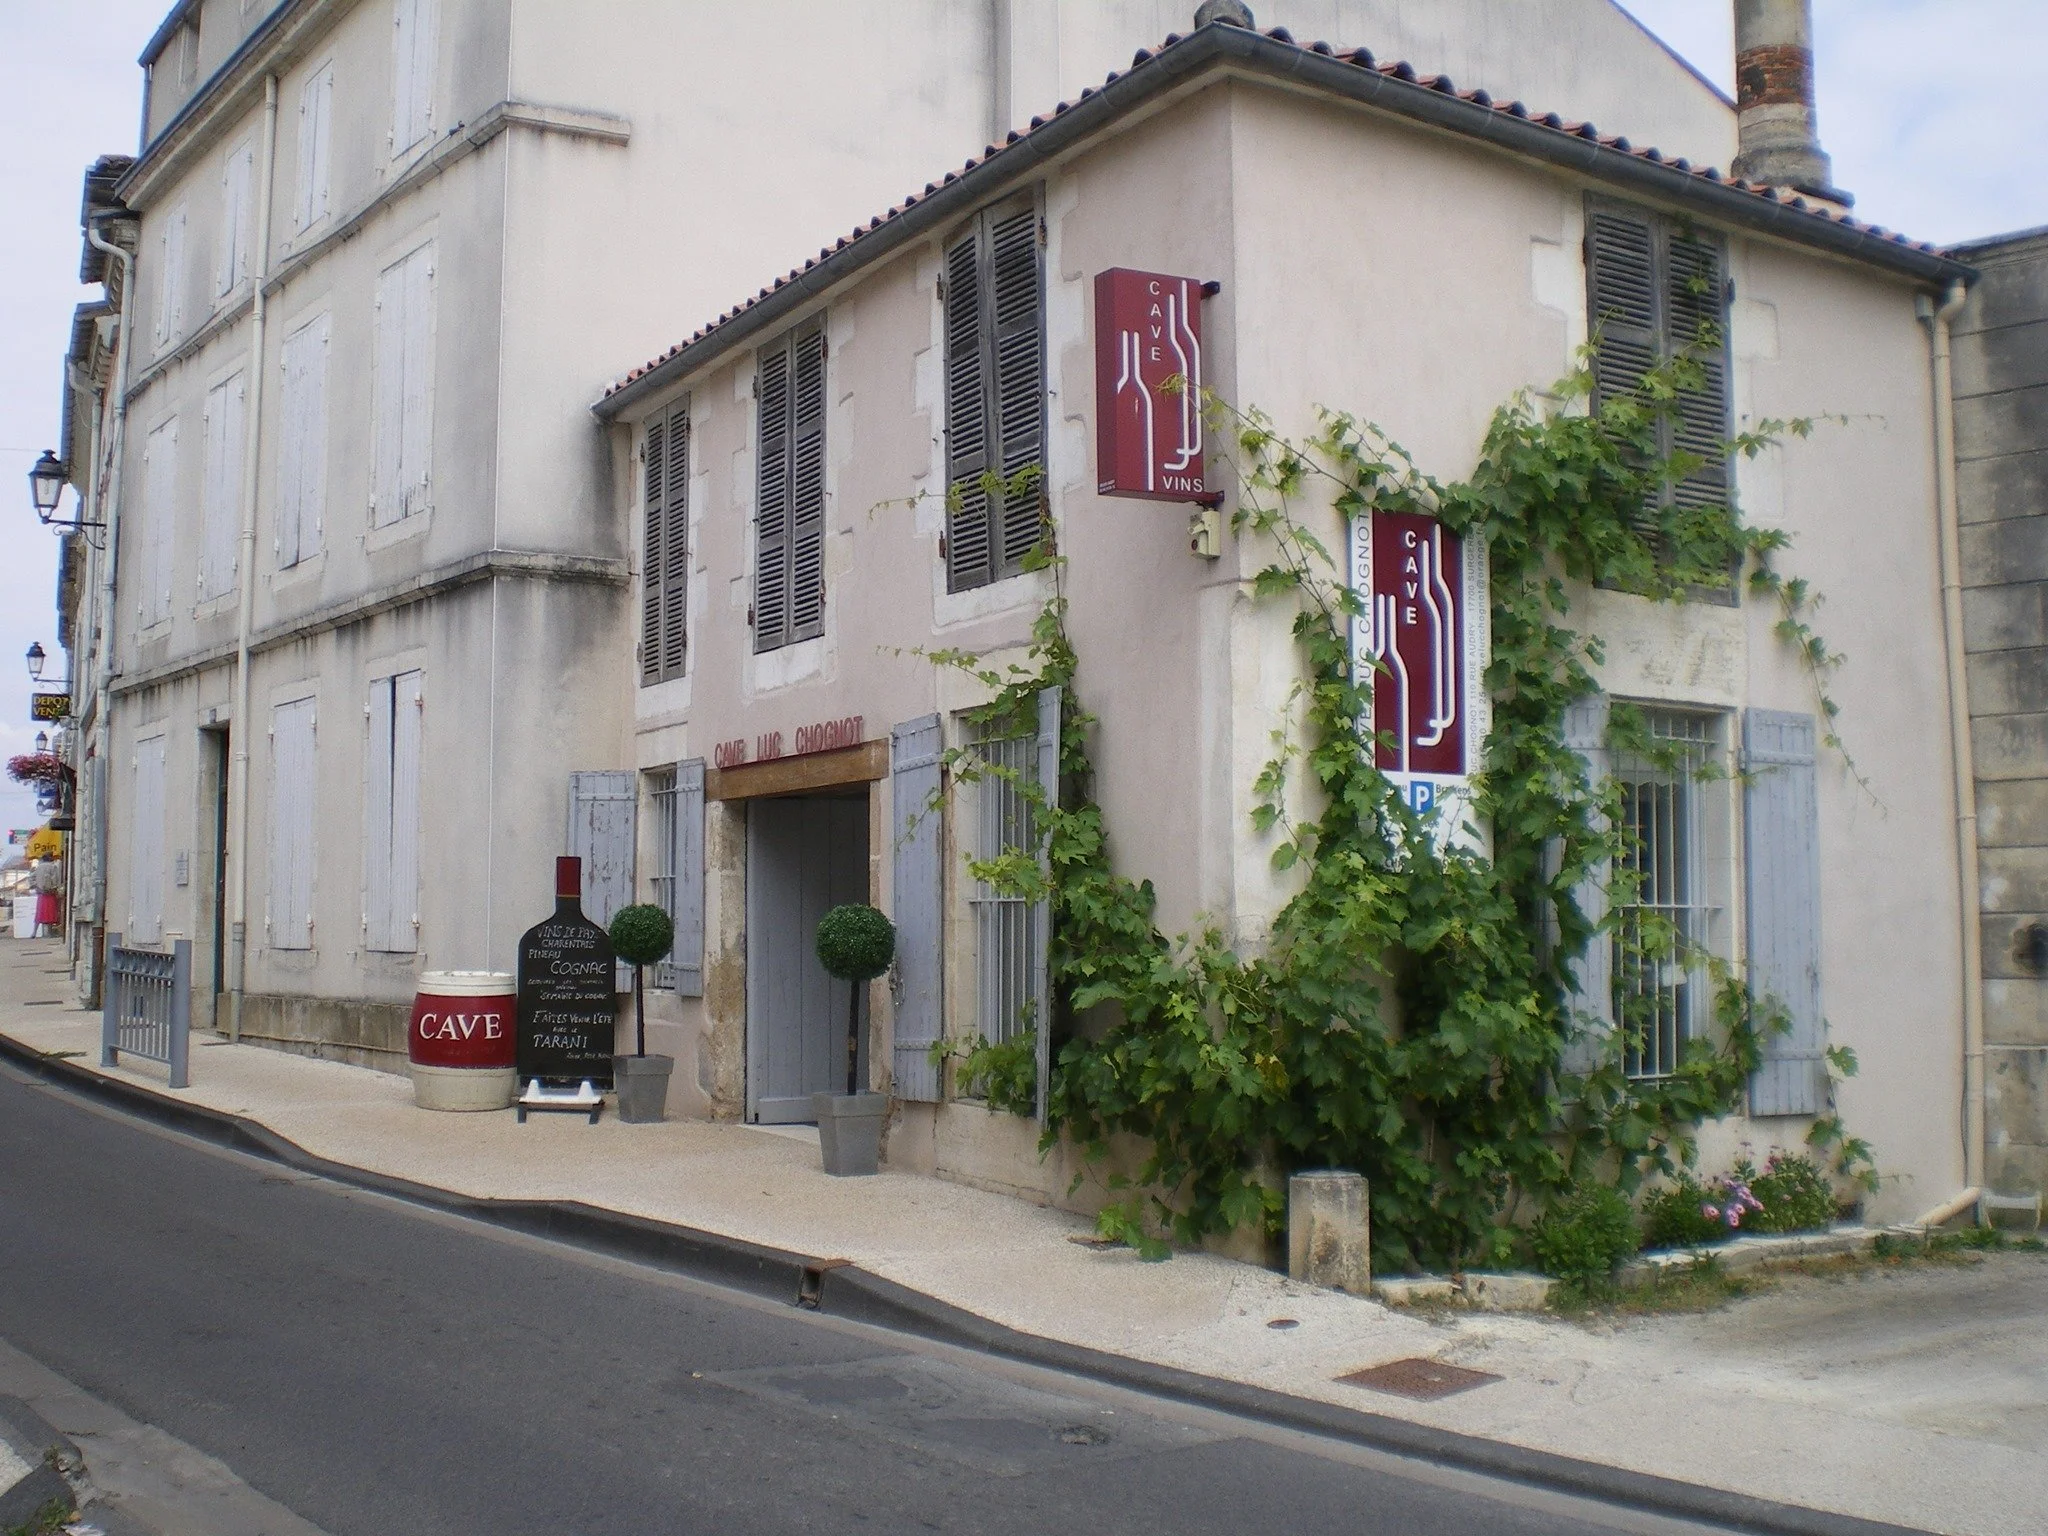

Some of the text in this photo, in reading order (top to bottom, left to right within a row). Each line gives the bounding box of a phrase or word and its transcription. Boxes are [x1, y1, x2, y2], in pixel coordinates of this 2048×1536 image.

[1149, 281, 1162, 361] CAVE
[1163, 475, 1203, 493] VINS
[1467, 533, 1475, 582] SURGERE
[1405, 530, 1418, 625] CAVE
[715, 715, 863, 768] CAVE LUC CHOGNOT
[1416, 785, 1430, 811] P
[34, 843, 57, 851] Pain
[538, 925, 562, 938] VINS
[528, 949, 561, 959] PINEAU
[541, 940, 595, 949] CHARENTAIS
[550, 961, 607, 975] COGNAC
[420, 1013, 502, 1040] CAVE
